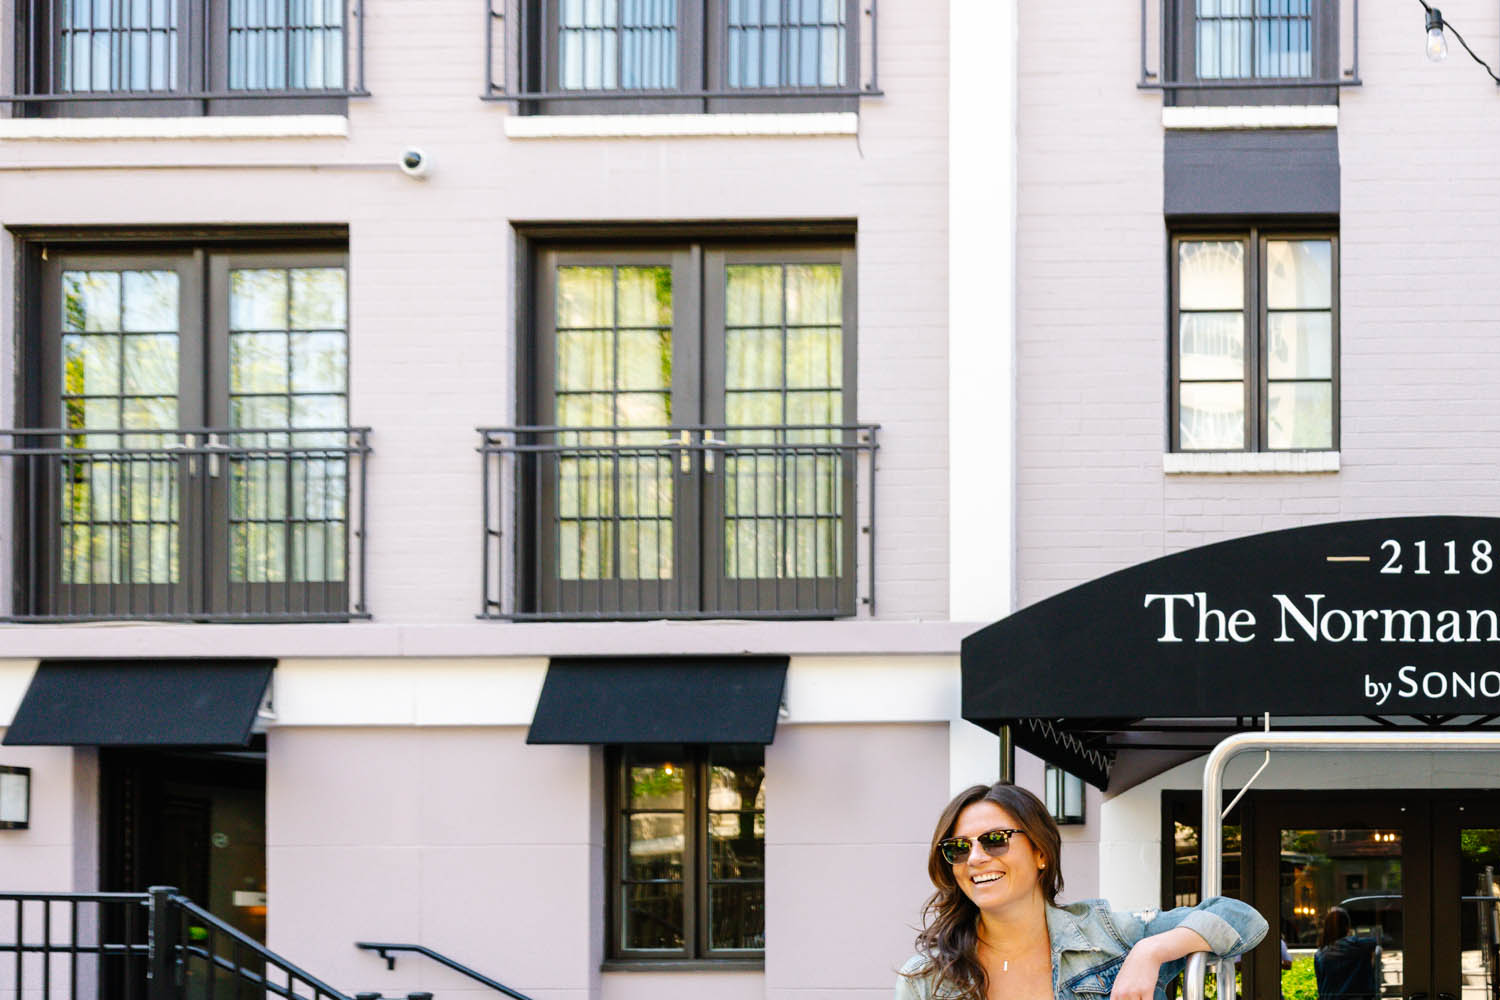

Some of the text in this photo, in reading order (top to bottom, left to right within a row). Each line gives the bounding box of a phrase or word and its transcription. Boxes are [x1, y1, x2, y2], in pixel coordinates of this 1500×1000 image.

[1379, 539, 1493, 575] 2118
[1143, 591, 1257, 643] The
[1364, 674, 1392, 706] by
